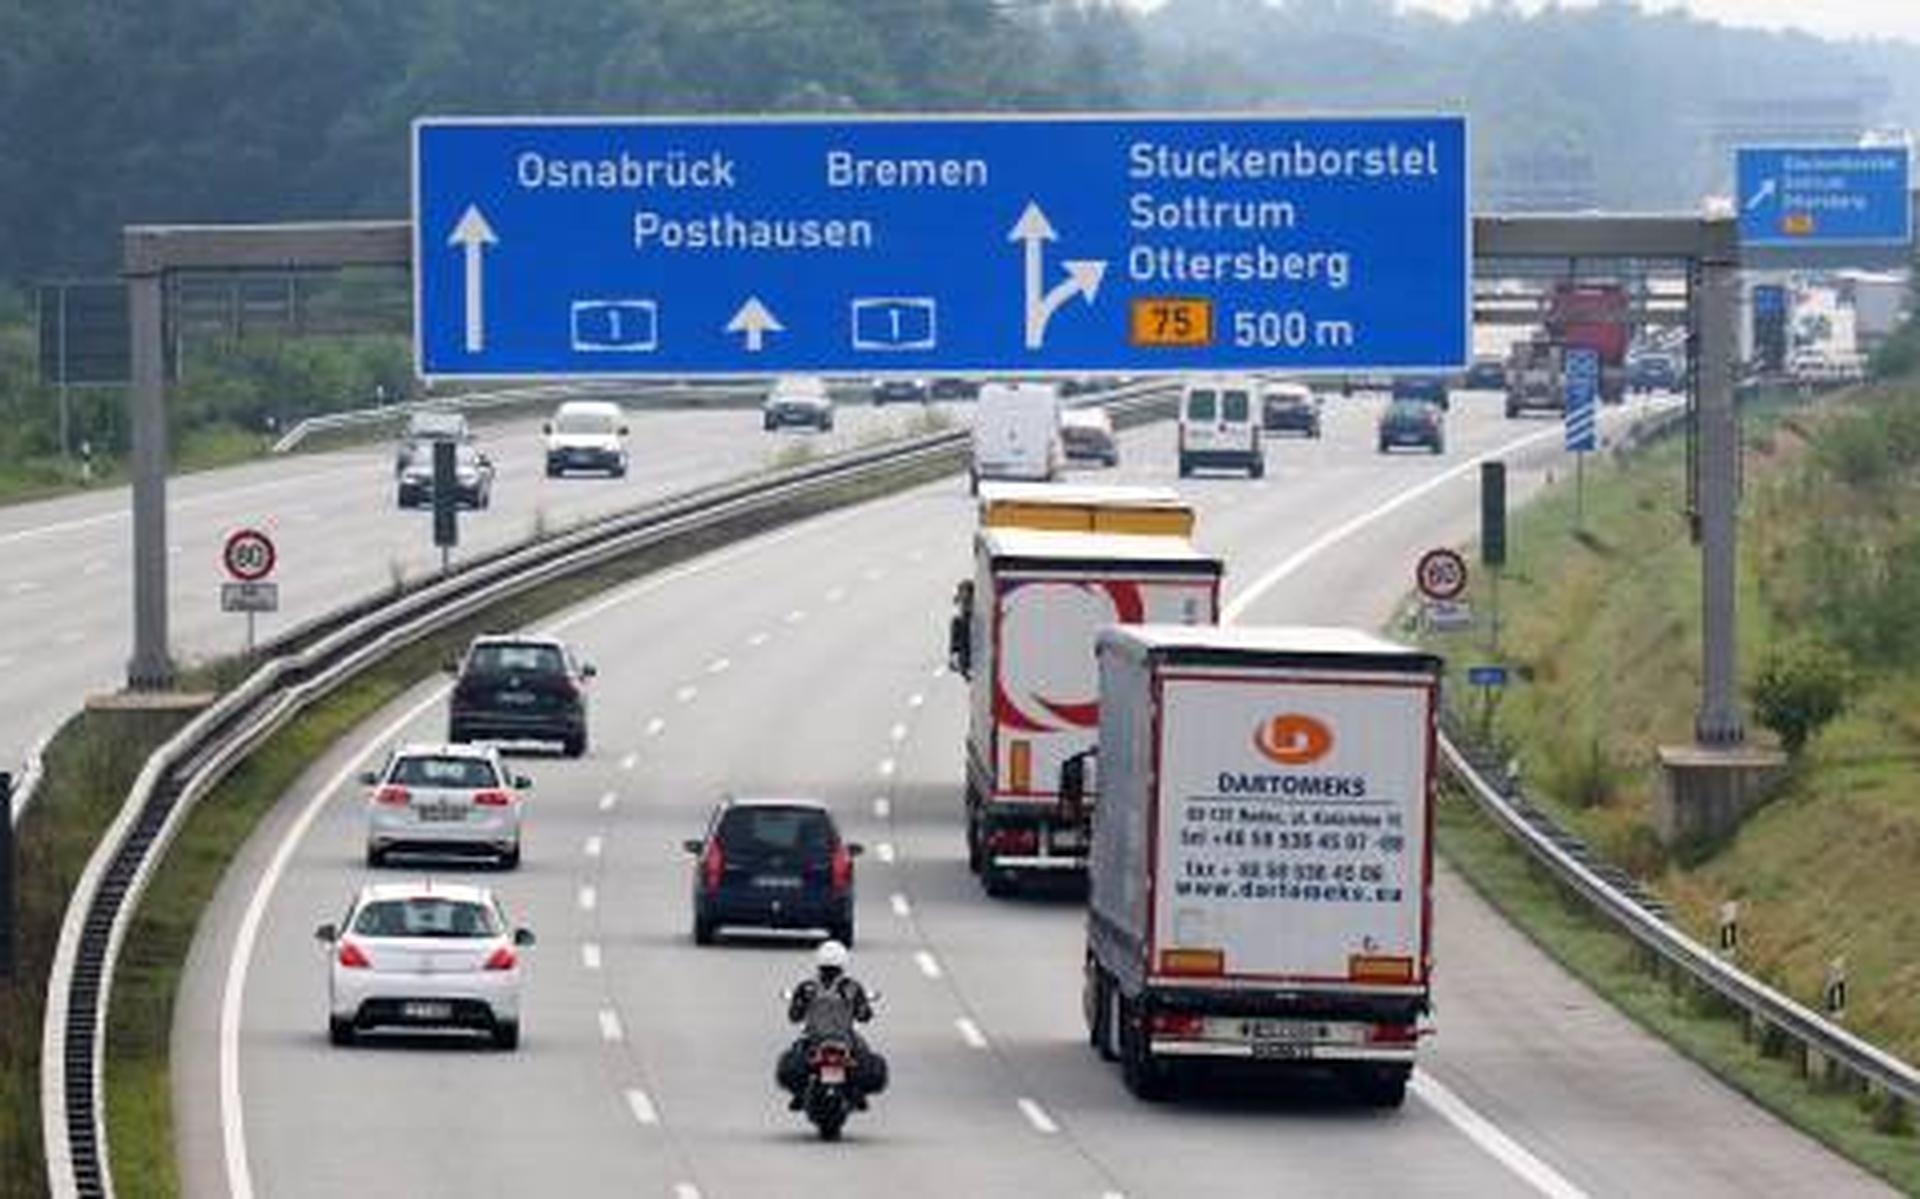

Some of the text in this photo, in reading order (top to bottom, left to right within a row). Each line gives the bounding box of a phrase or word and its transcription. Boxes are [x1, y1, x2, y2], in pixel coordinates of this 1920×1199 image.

[516, 151, 988, 188] Osnabrück Bremen
[1129, 141, 1439, 179] Stuckenborstel
[1129, 194, 1295, 229] Sottrum
[634, 212, 872, 249] Posthausen
[1129, 245, 1350, 288] Ottersberg
[608, 310, 620, 339] 1
[1151, 306, 1192, 336] 75
[1234, 312, 1354, 347] 500 m
[1218, 772, 1367, 797] DARTOMEKS
